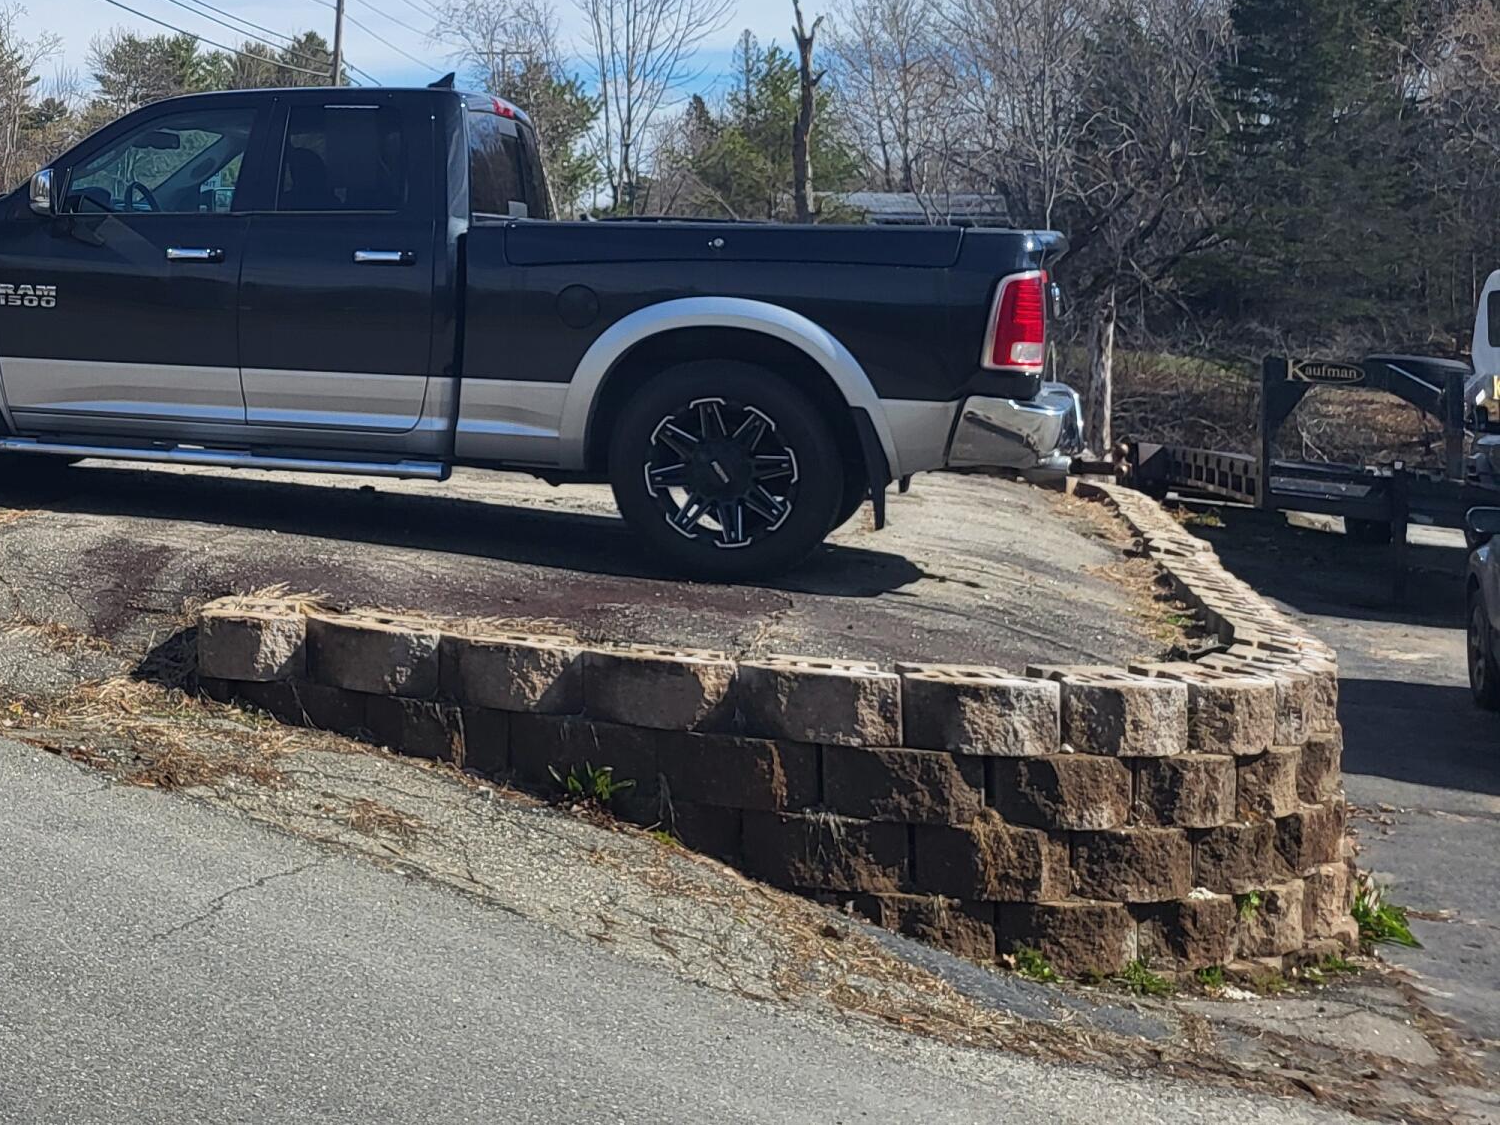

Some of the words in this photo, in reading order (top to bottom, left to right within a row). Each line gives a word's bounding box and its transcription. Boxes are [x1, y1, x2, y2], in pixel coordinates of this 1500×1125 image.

[0, 283, 57, 296] RAM
[0, 295, 56, 308] 1500
[1285, 359, 1357, 382] Kaufman
